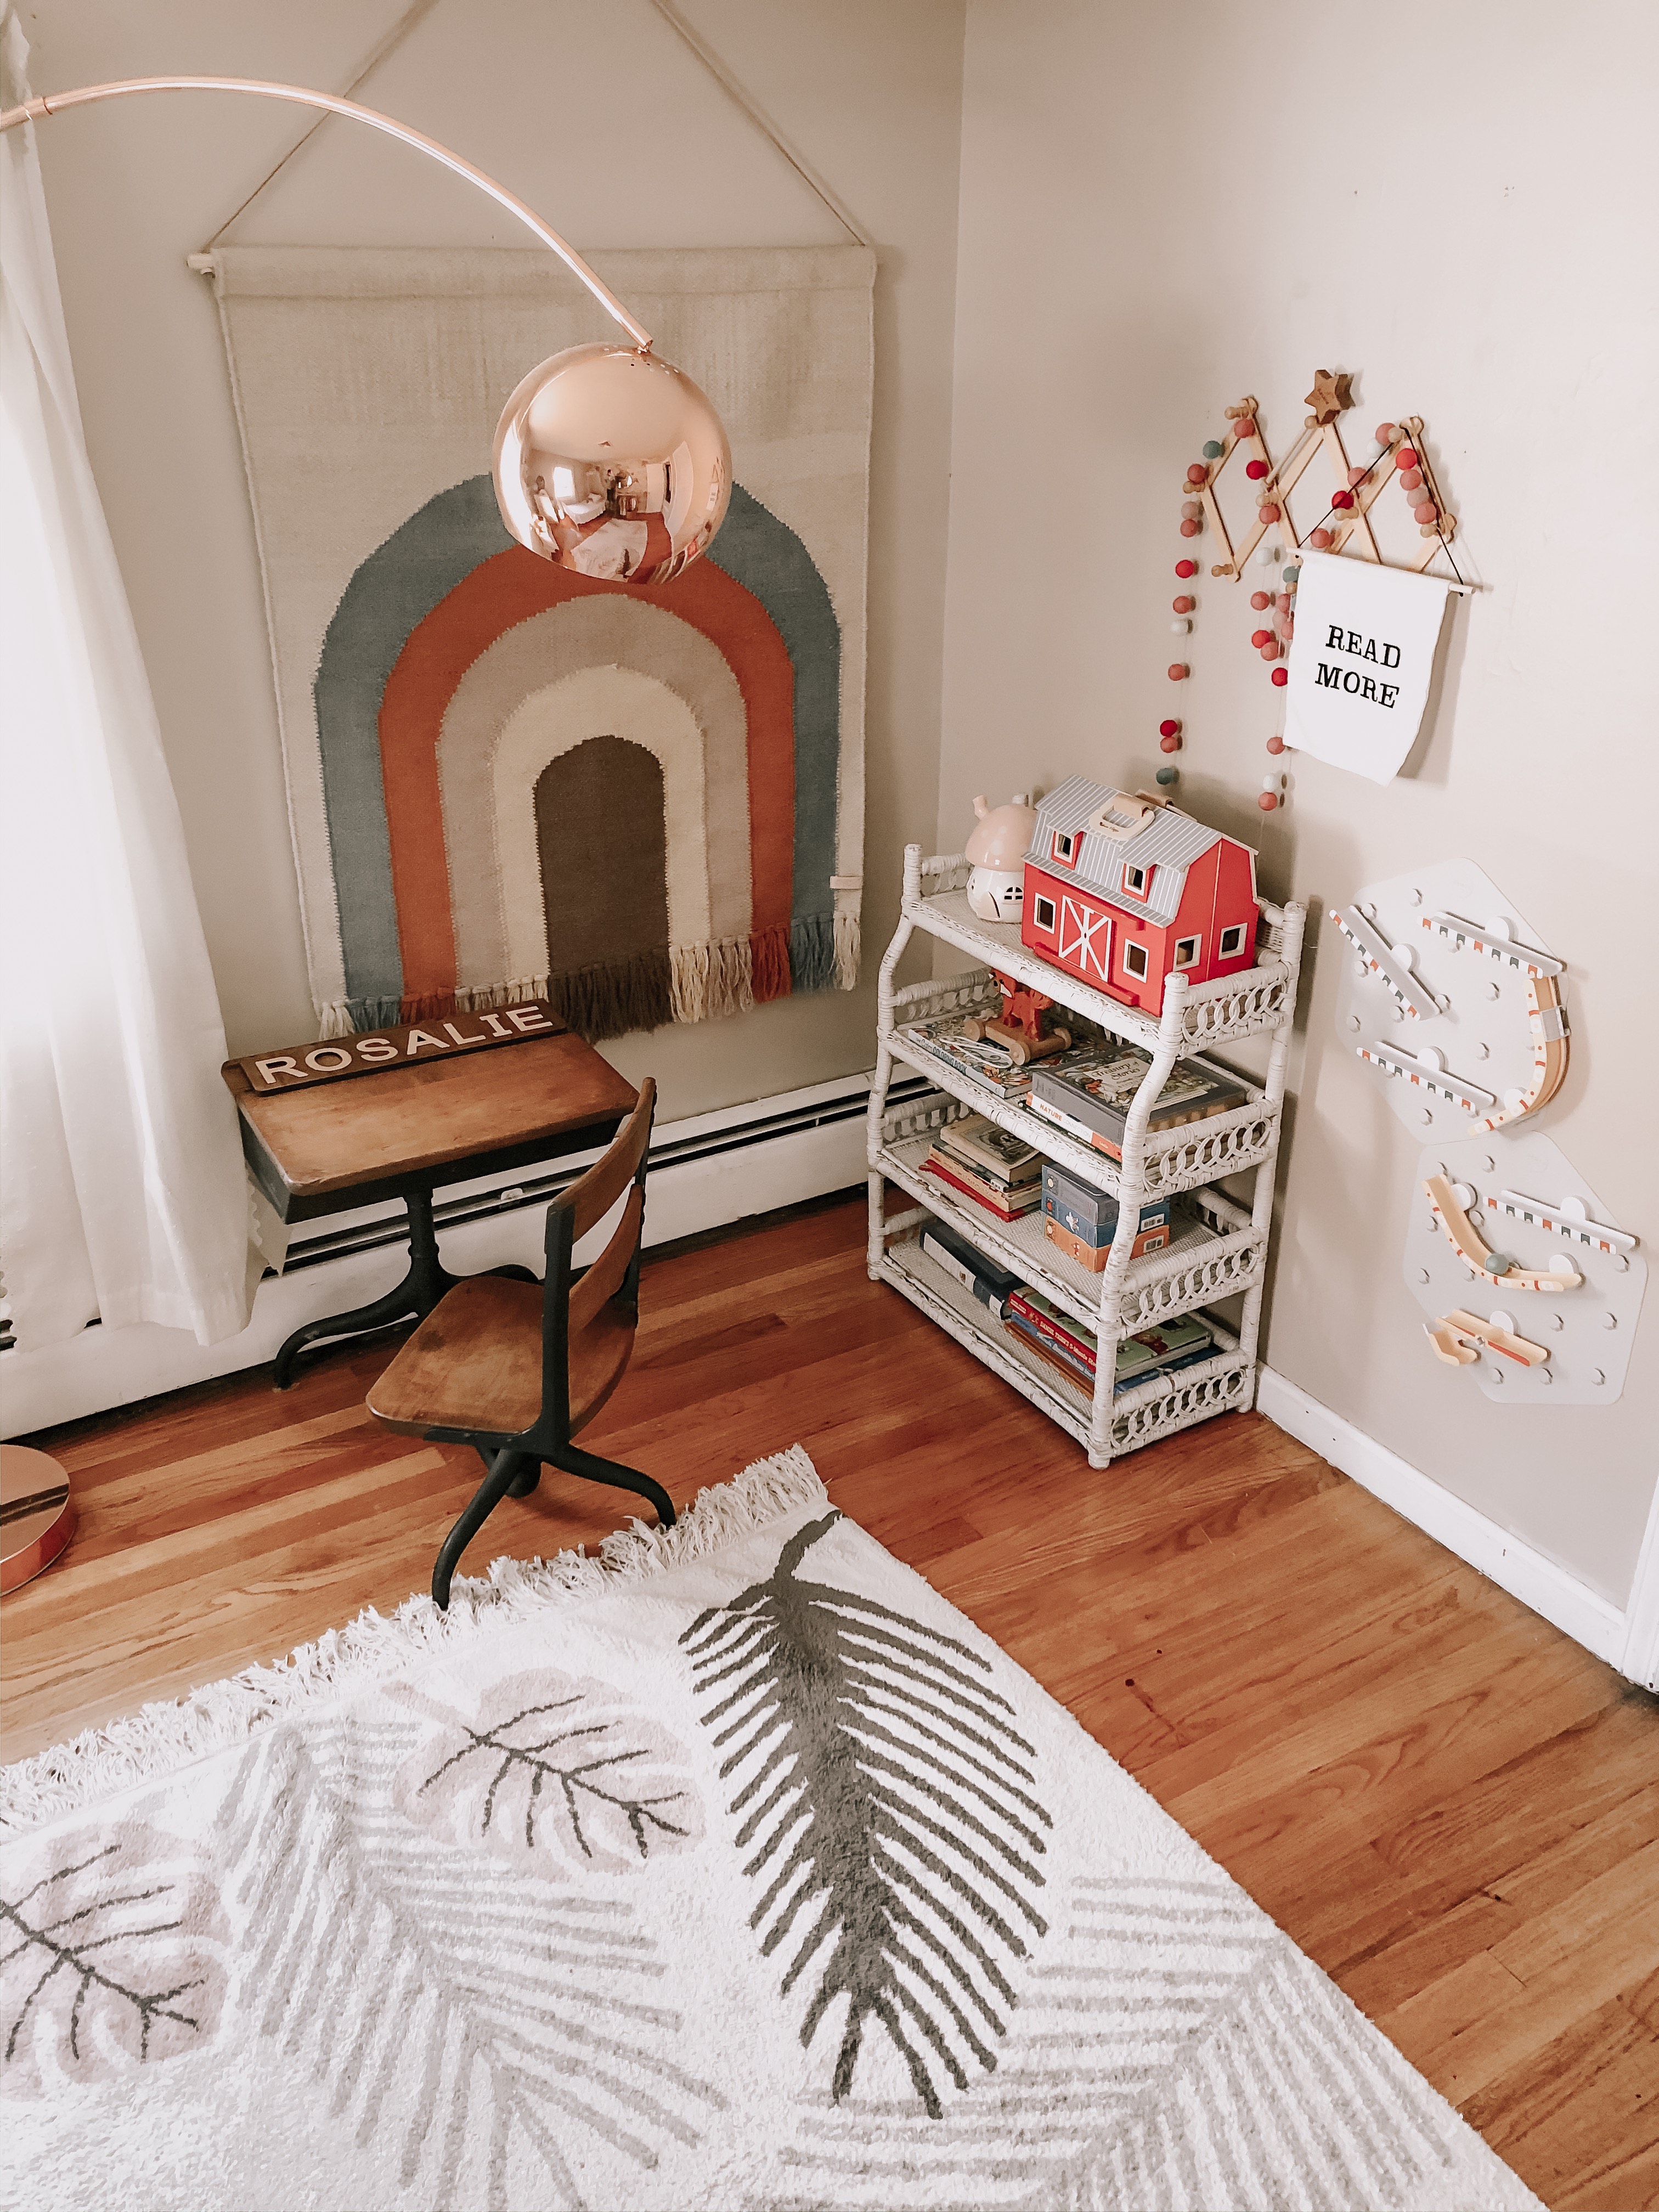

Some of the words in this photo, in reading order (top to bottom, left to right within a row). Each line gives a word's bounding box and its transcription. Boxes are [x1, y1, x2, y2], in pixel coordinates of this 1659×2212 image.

[1325, 625, 1401, 668] READ
[1315, 663, 1400, 708] MORE
[255, 1006, 552, 1085] ROSALIE
[933, 1047, 954, 1065] COLORING
[955, 1060, 967, 1075] BOOK
[1091, 1063, 1131, 1076] Treasury
[1111, 1068, 1141, 1080] Stories
[1040, 1103, 1062, 1121] NATURE
[1063, 1118, 1091, 1138] CONNECTION
